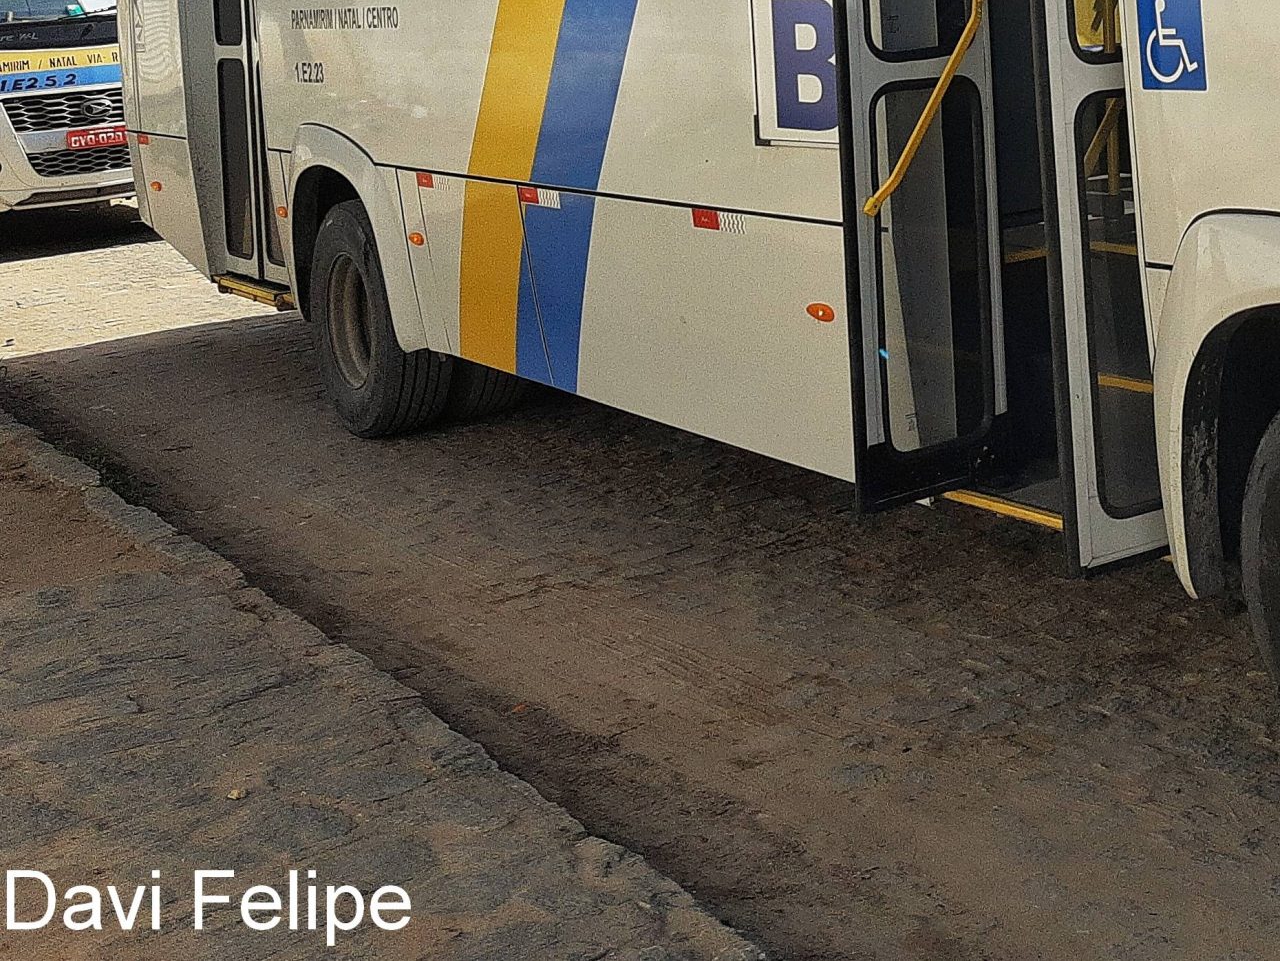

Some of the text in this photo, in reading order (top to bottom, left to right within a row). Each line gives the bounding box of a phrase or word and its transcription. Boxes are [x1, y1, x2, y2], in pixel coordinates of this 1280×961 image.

[291, 8, 334, 30] PARNAMIRIM
[338, 8, 362, 29] NATAL
[366, 6, 399, 29] CENTRO
[49, 55, 78, 69] NATAL
[294, 62, 325, 84] 1.E2.23
